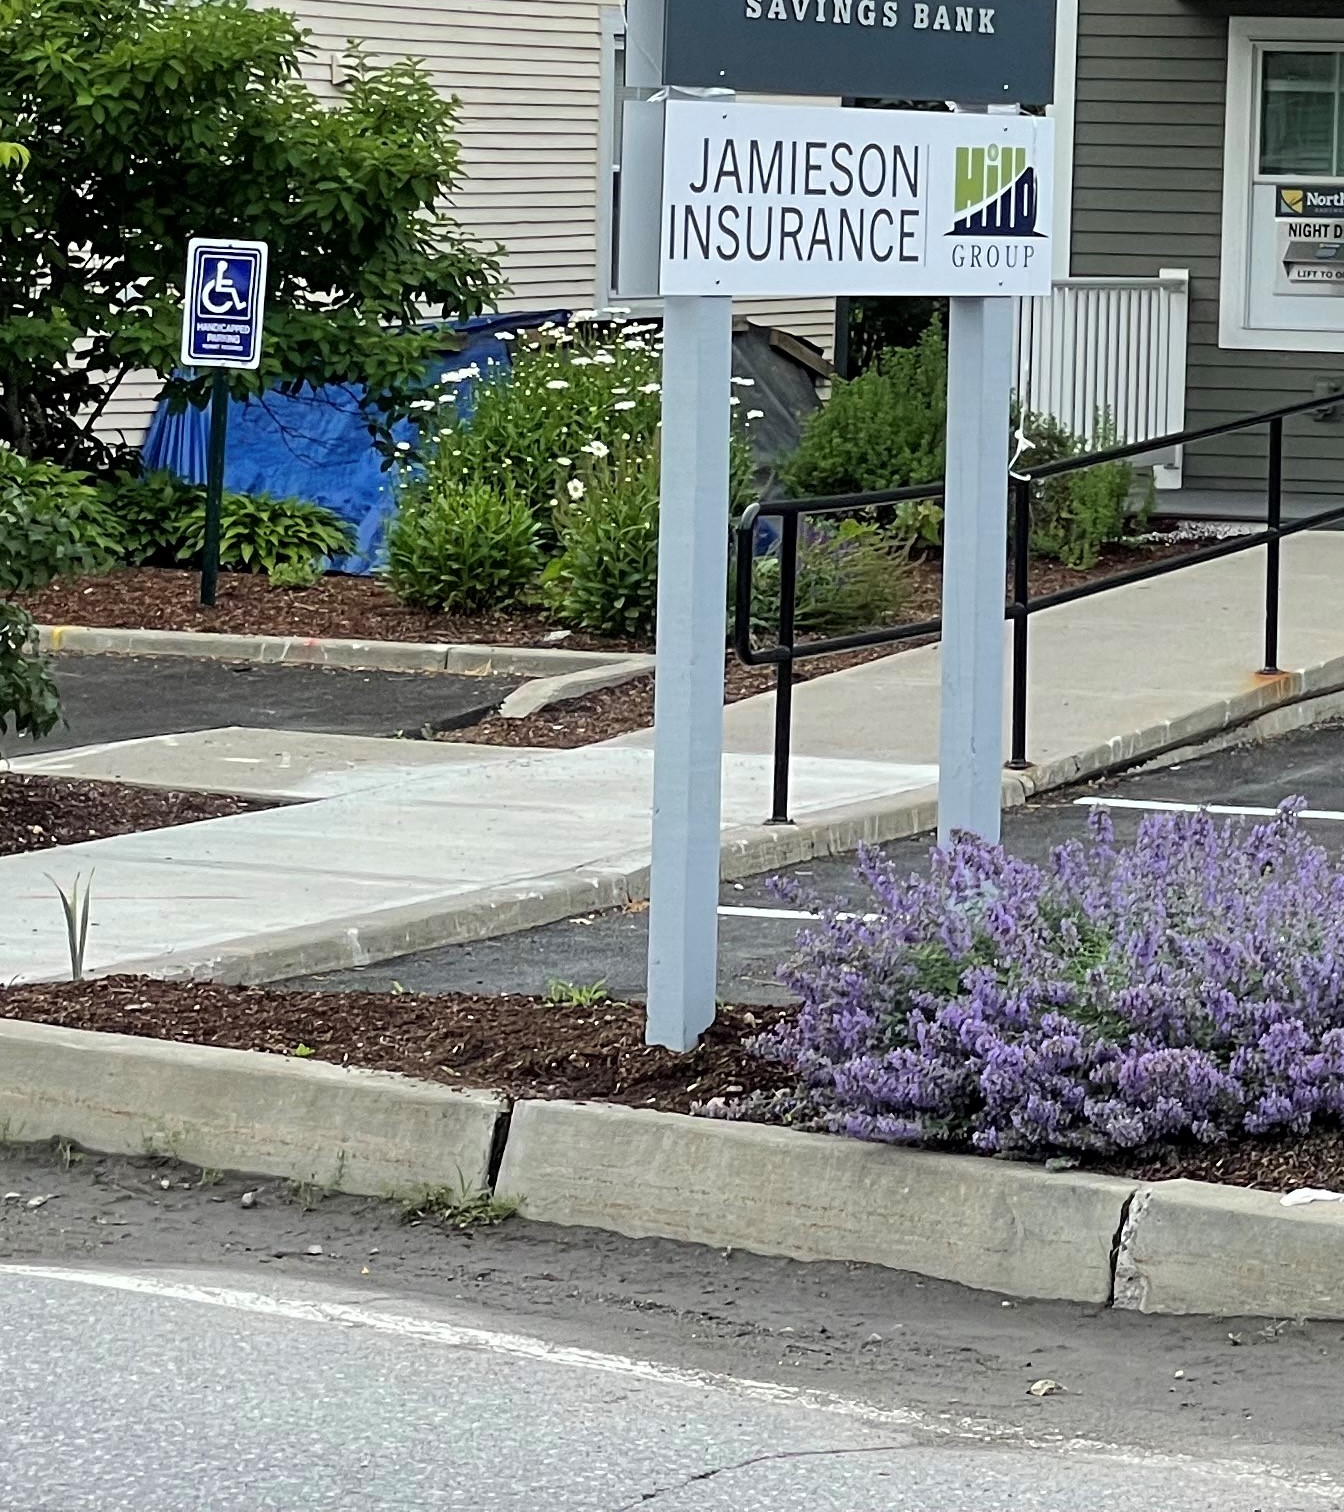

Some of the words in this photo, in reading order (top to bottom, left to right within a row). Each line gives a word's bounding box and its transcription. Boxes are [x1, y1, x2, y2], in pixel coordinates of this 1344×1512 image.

[913, 2, 996, 34] BANK
[689, 137, 919, 198] JAMIESON
[669, 204, 920, 263] INSURANCE
[1288, 223, 1330, 238] NIGHT
[951, 244, 1035, 268] GROUP
[1297, 270, 1318, 278] LIFT
[1320, 271, 1334, 279] TO
